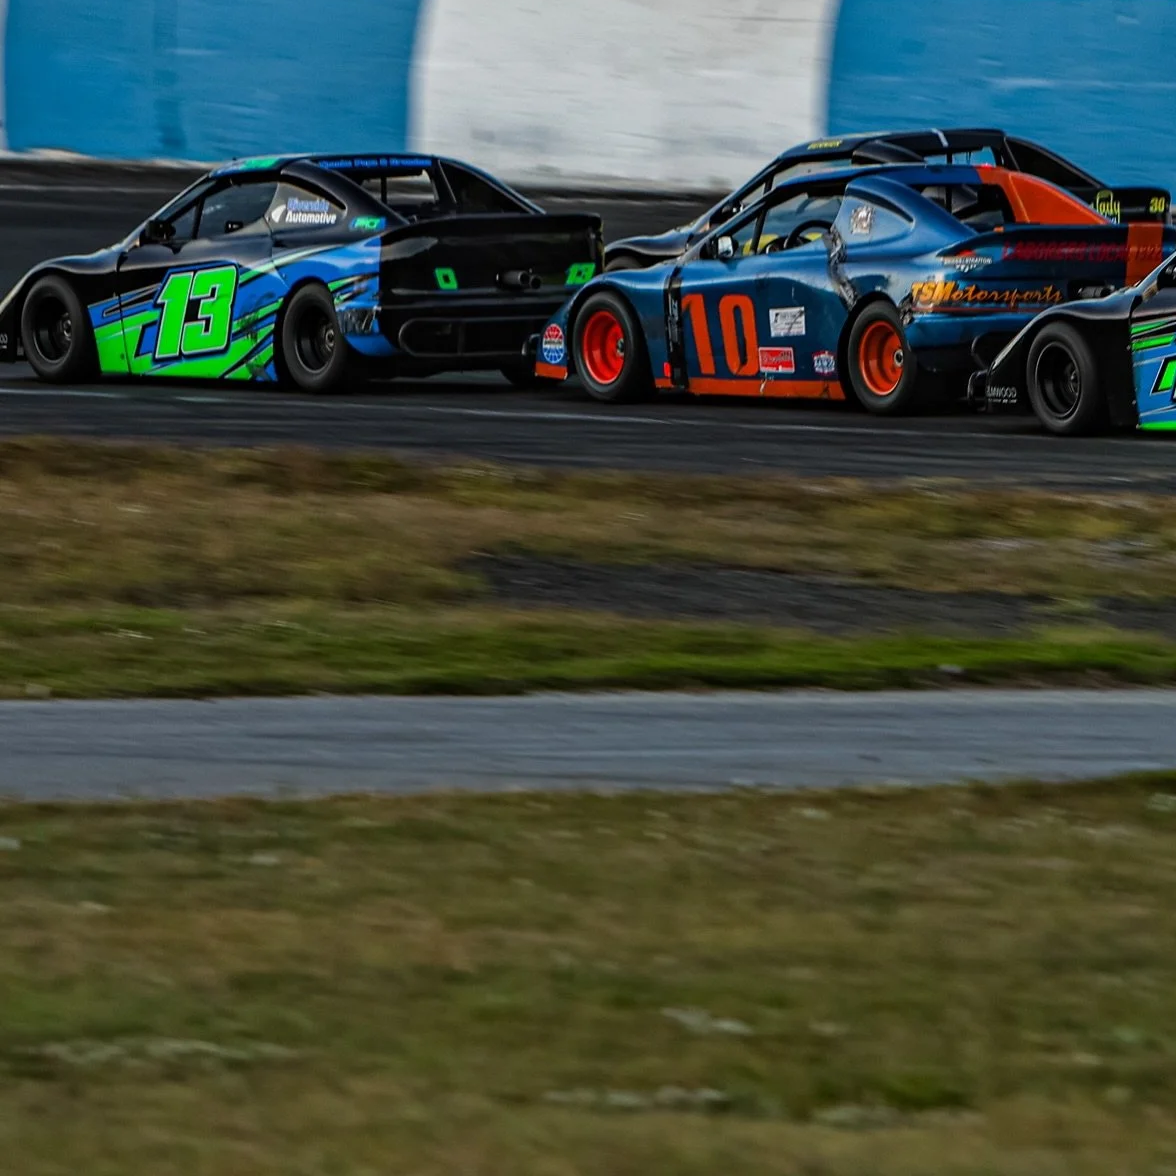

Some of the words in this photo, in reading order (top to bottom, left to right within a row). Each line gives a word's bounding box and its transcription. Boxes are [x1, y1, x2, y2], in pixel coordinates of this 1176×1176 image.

[285, 210, 337, 224] Automotive
[1149, 197, 1166, 214] 30
[565, 262, 596, 285] 13
[155, 264, 237, 360] 13
[681, 293, 760, 377] 10
